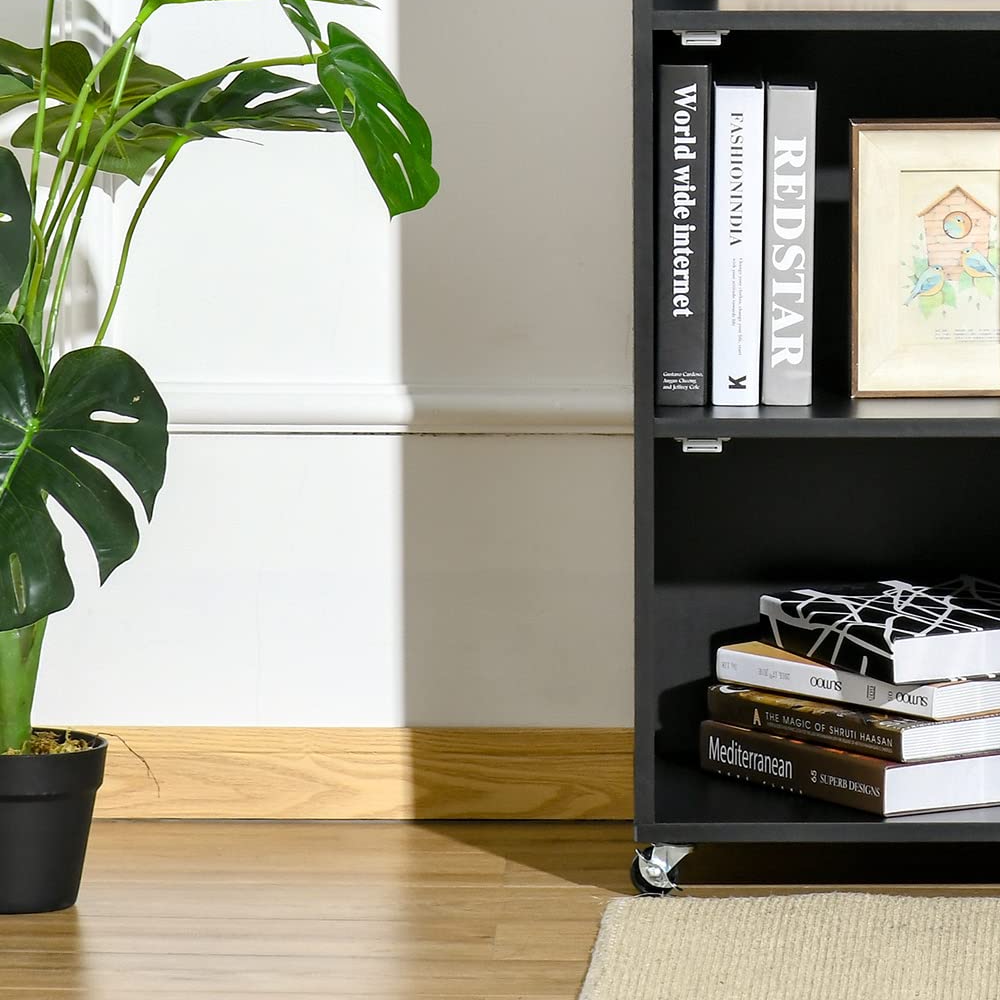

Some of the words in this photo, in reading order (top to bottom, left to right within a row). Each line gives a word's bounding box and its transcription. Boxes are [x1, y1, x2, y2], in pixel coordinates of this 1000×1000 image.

[673, 82, 697, 161] World
[673, 164, 697, 220] wide
[729, 112, 744, 246] FASHIONINDIA
[672, 223, 697, 318] internet
[771, 135, 807, 369] REDSTAR
[728, 375, 747, 390] K
[708, 735, 793, 780] Mediterranean
[765, 711, 780, 723] THE
[782, 716, 812, 730] MAGIC
[814, 723, 826, 732] OF
[829, 726, 858, 740] SHRUTI
[860, 732, 894, 748] HAASAN
[819, 773, 849, 789] SUPERB
[848, 780, 881, 798] DESIGNS
